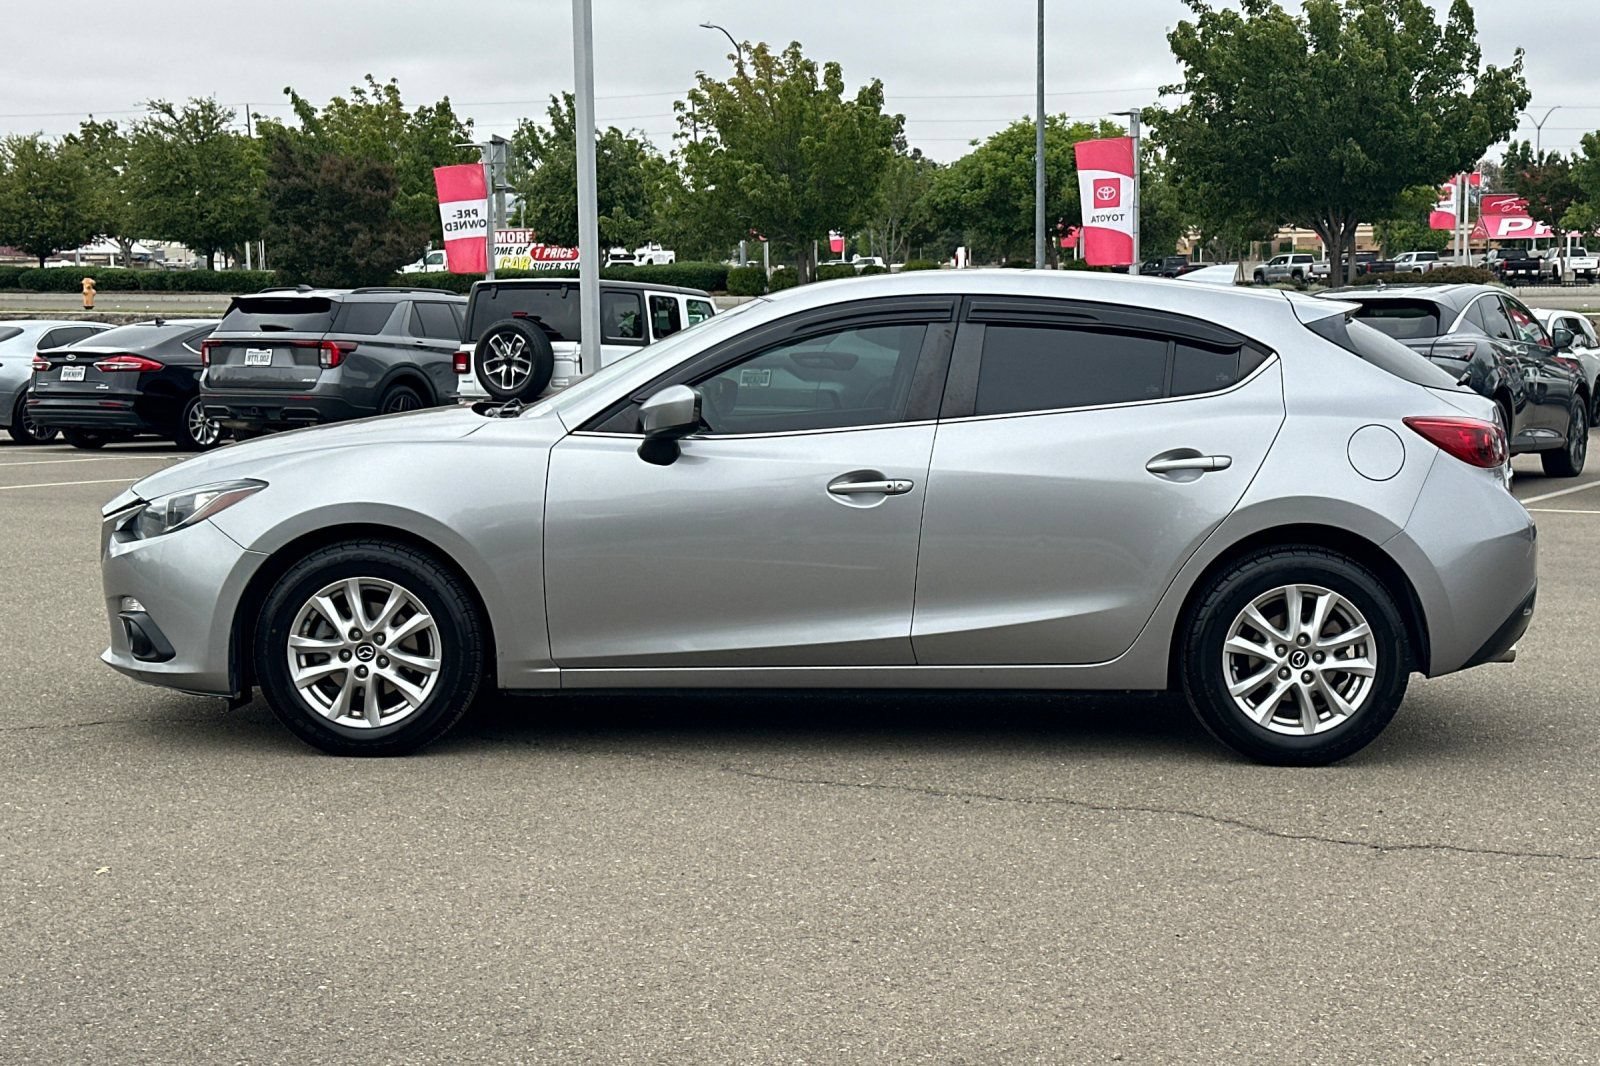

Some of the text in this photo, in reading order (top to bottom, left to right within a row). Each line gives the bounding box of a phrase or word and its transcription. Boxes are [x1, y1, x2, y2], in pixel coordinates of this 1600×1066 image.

[515, 246, 528, 256] OF
[542, 247, 575, 259] PRICE
[499, 256, 532, 270] CAR
